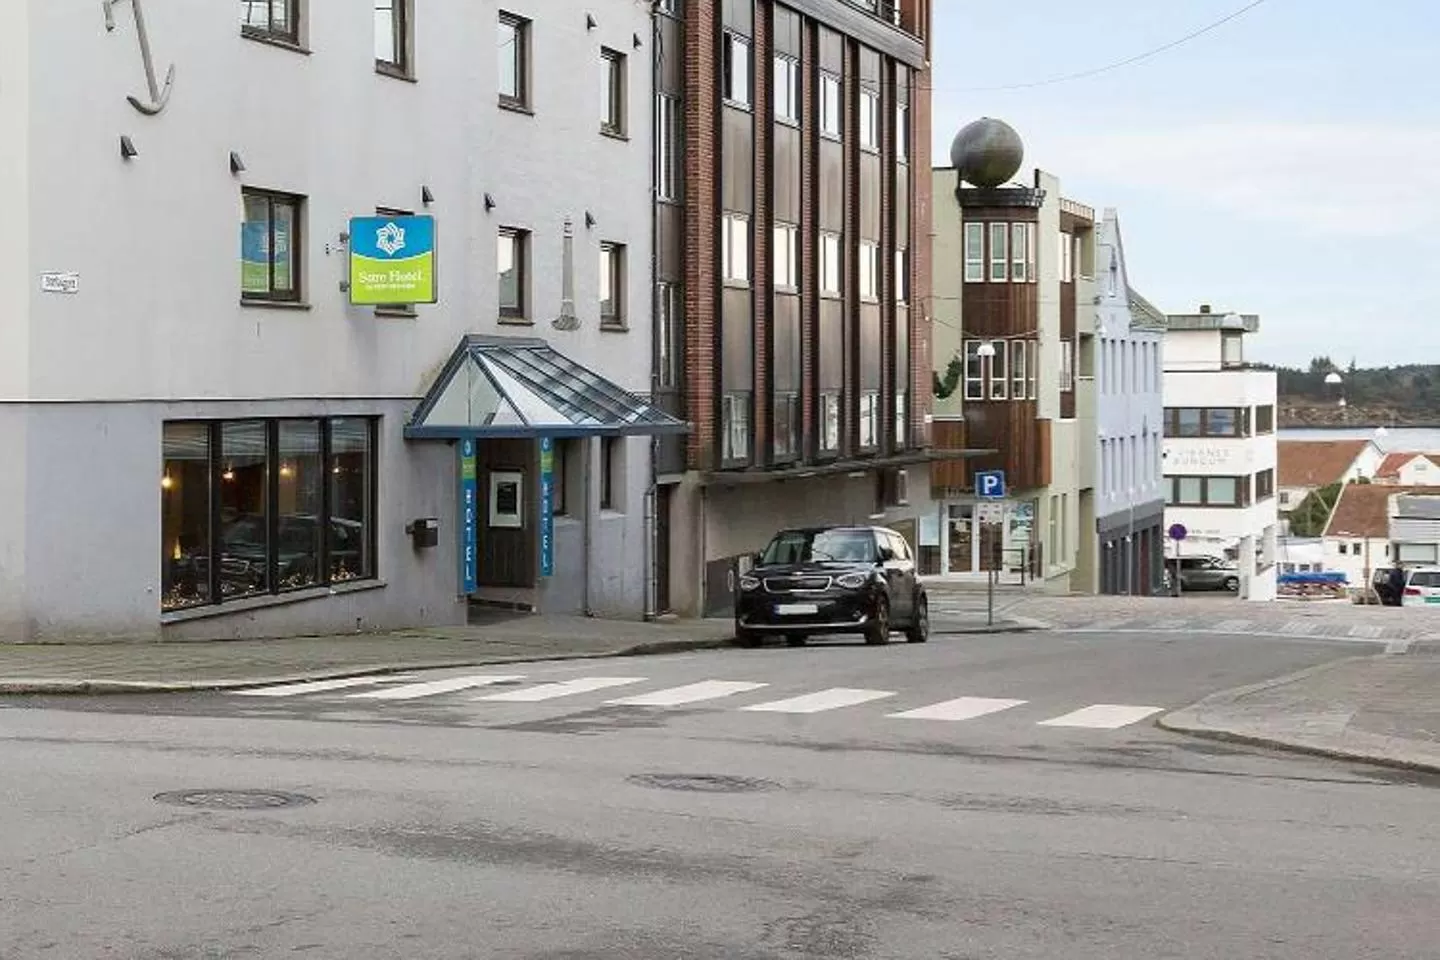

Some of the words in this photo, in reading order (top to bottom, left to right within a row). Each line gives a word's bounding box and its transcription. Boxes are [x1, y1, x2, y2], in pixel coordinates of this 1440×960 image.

[389, 269, 423, 282] Hotel
[983, 475, 998, 494] P
[465, 489, 473, 581] HOTEL
